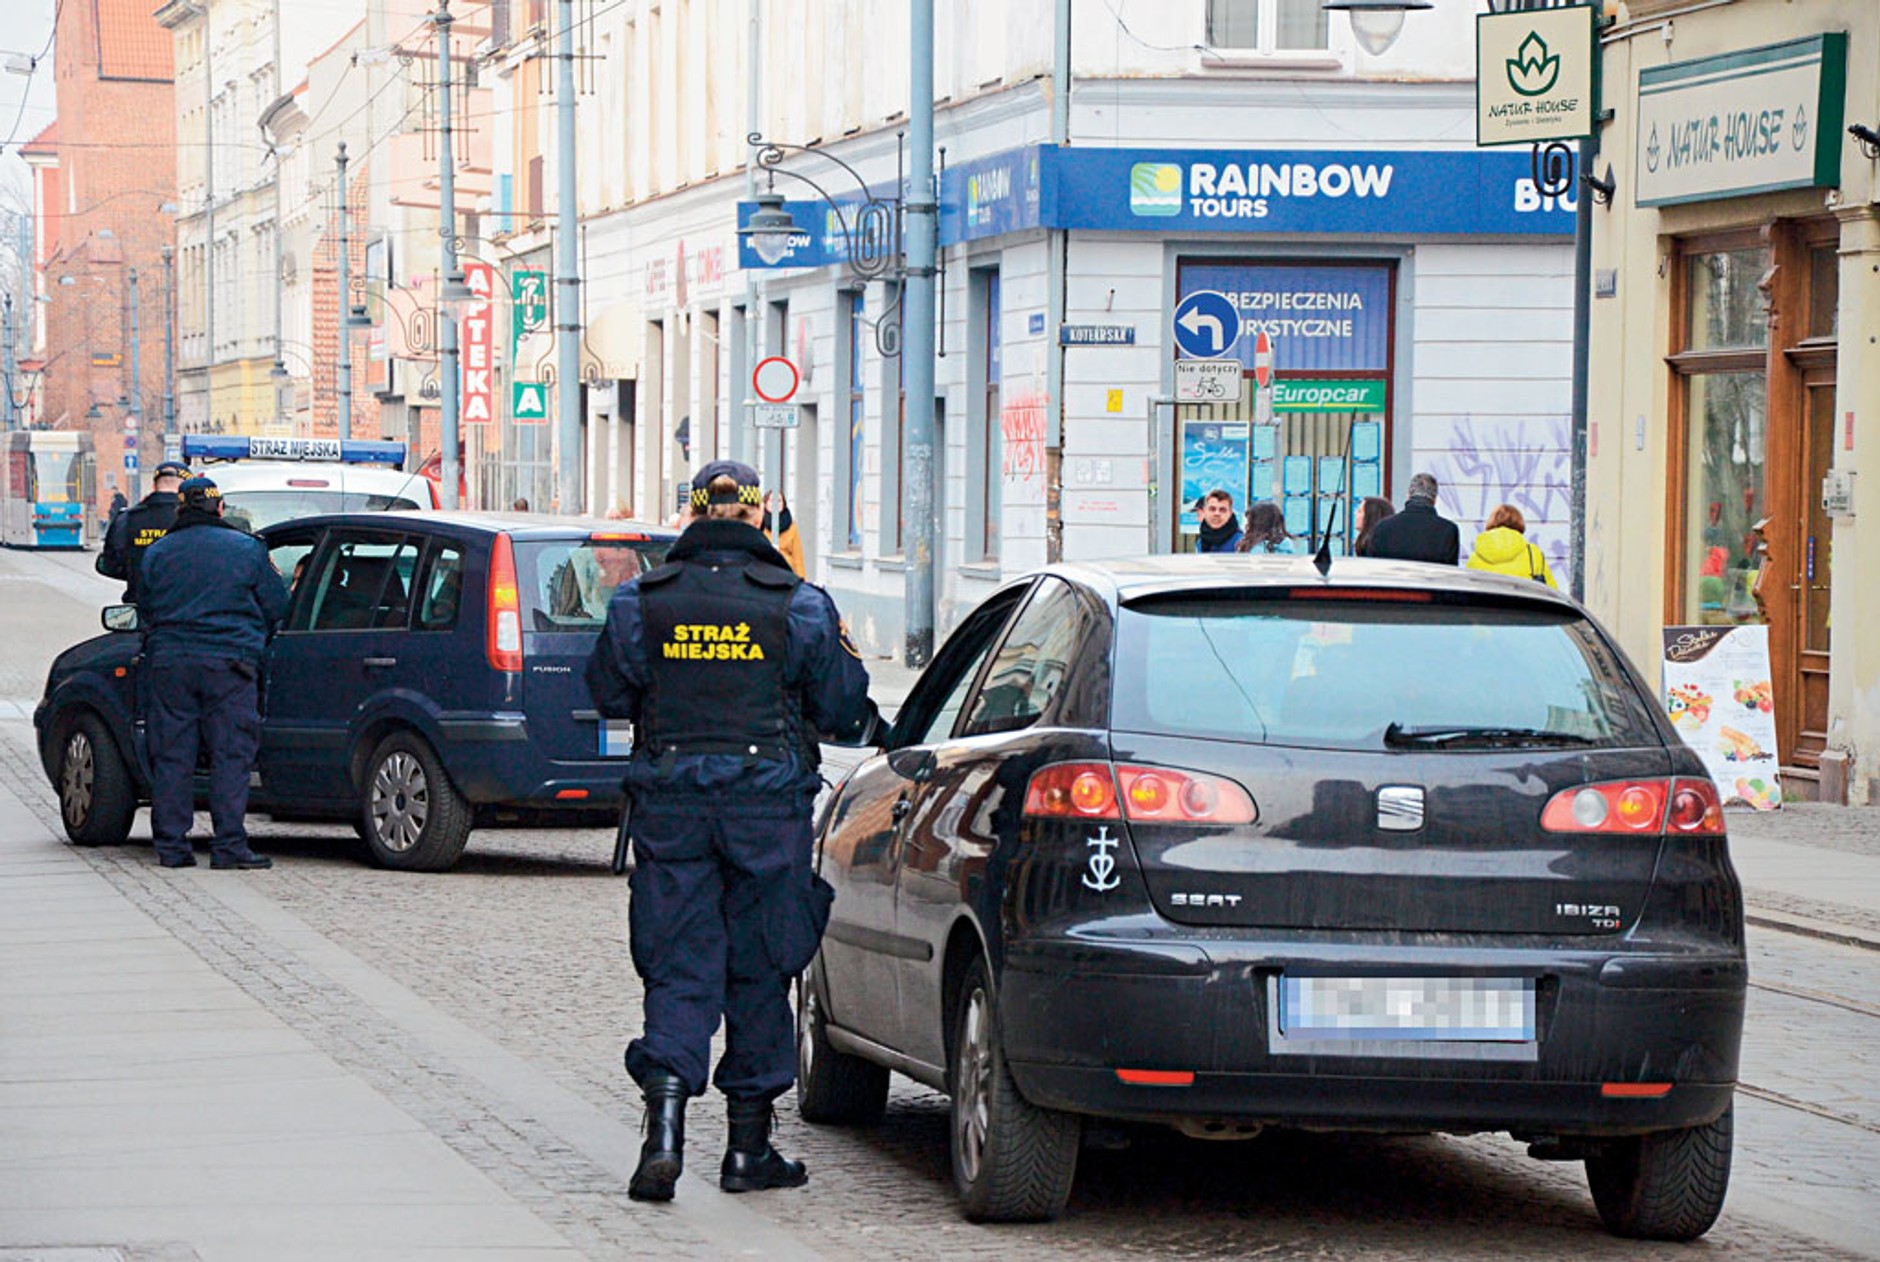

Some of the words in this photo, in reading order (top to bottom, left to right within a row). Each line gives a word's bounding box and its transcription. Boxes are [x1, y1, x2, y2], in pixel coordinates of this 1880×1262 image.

[1488, 102, 1532, 117] NATUR
[1536, 99, 1578, 114] HOUSE
[1667, 115, 1720, 169] NATUR
[1724, 109, 1785, 161] HOUSE
[1190, 163, 1393, 198] RAINBOW
[1515, 178, 1578, 212] BIU
[1190, 199, 1268, 218] TOURS
[1223, 291, 1363, 311] BEZPIECZENIA
[465, 268, 490, 420] APTEKA
[1178, 365, 1195, 373] Nie
[1199, 365, 1238, 376] dotyczy
[1273, 384, 1370, 407] Europcar
[290, 440, 339, 457] MIEJSKA
[673, 621, 751, 642] STRAŻ
[662, 642, 765, 660] MIEJSKA
[1171, 893, 1242, 907] SEAT
[1556, 903, 1620, 917] IBIZA
